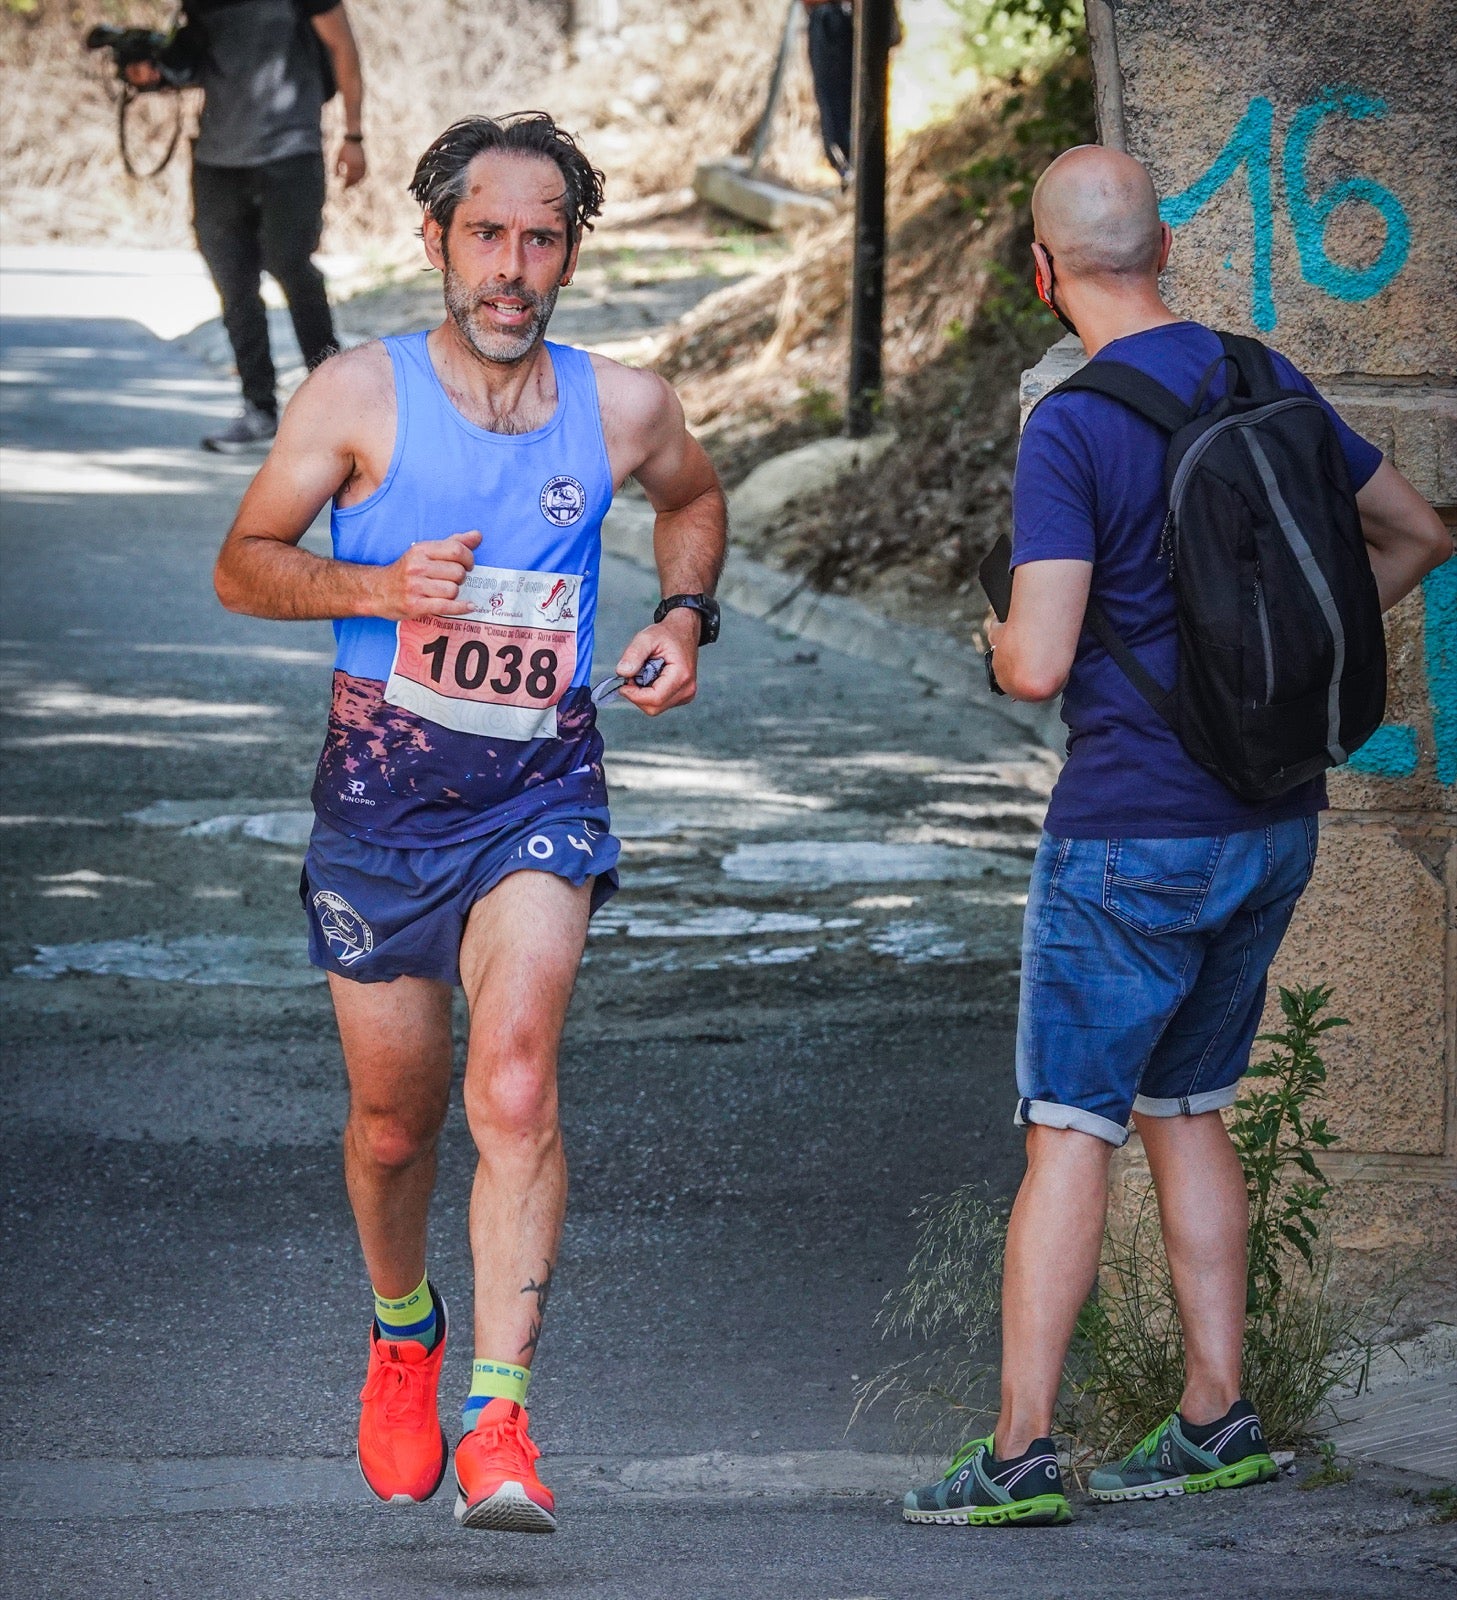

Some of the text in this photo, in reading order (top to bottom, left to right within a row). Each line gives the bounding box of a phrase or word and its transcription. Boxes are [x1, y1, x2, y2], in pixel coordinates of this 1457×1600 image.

[464, 576, 498, 591] REMIO
[422, 635, 558, 700] 1038
[340, 793, 376, 807] RUNOPRO
